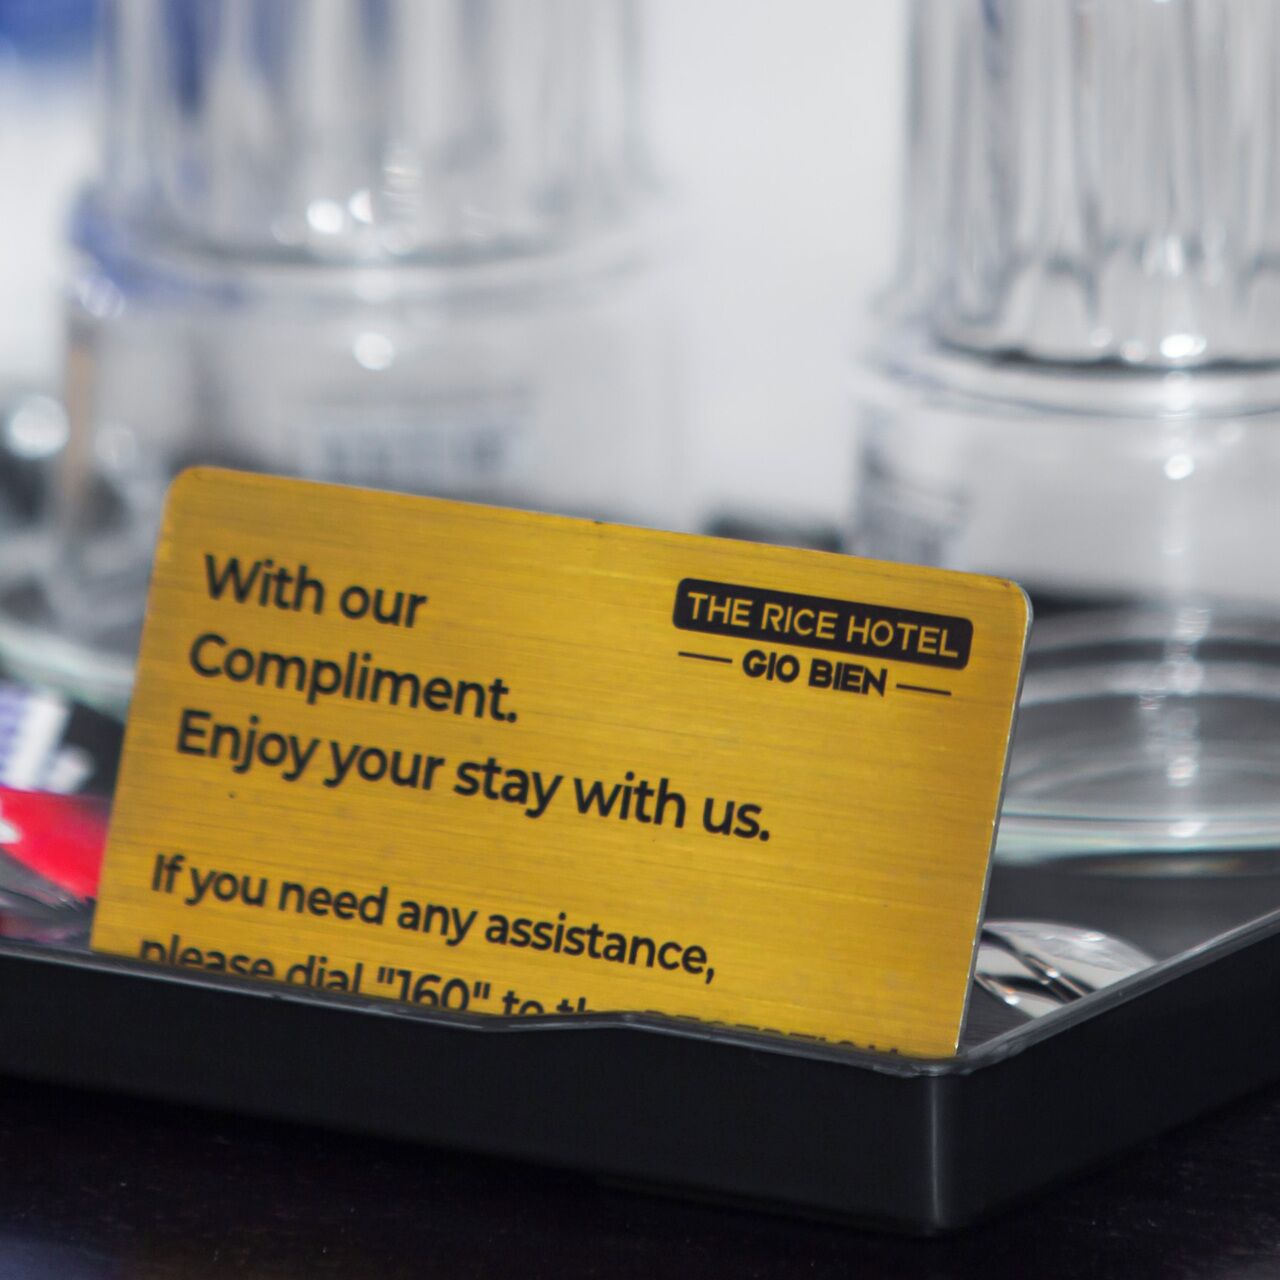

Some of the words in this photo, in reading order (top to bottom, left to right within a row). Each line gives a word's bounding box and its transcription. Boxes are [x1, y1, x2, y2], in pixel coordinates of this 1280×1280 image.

[204, 554, 325, 615] With
[339, 585, 428, 628] our
[687, 591, 754, 628] THE
[760, 603, 839, 641] RICE
[846, 616, 959, 658] HOTEL
[189, 632, 518, 723] Compliment.
[741, 649, 801, 683] GIO
[808, 658, 888, 697] BIEN
[176, 708, 320, 783] Enjoy
[323, 740, 446, 790] your
[453, 757, 565, 819] stay
[574, 771, 687, 829] with
[702, 797, 770, 842] us.
[152, 852, 186, 894] If
[184, 867, 268, 907] you
[278, 885, 390, 926] need
[396, 900, 478, 947] any
[484, 912, 716, 986] assistance,
[285, 955, 364, 995] dial
